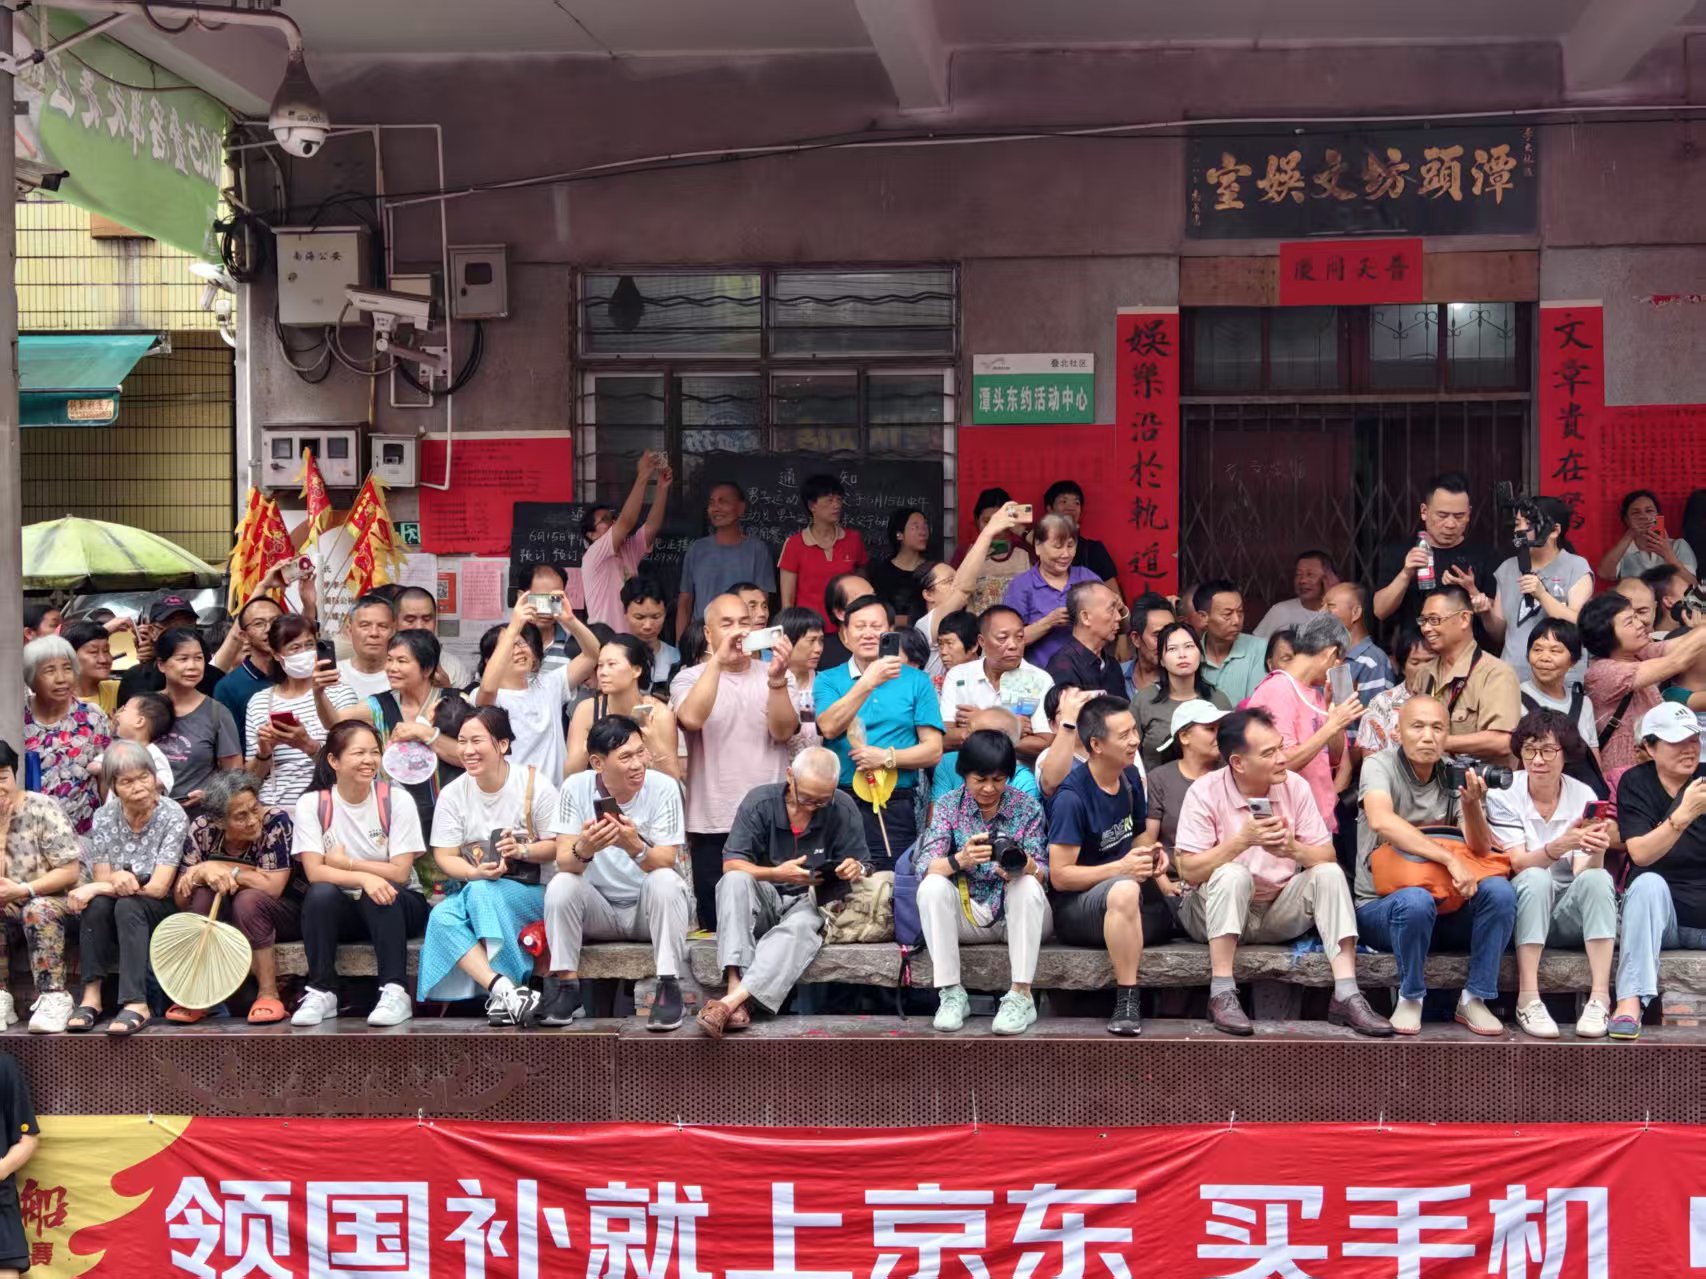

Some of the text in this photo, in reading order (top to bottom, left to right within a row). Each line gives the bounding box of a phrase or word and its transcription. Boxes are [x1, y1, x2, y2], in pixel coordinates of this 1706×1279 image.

[979, 384, 1088, 412] 潭头东约活动中心
[165, 1177, 1137, 1279] 领国补就上京东
[1197, 1184, 1609, 1279] 买手机
